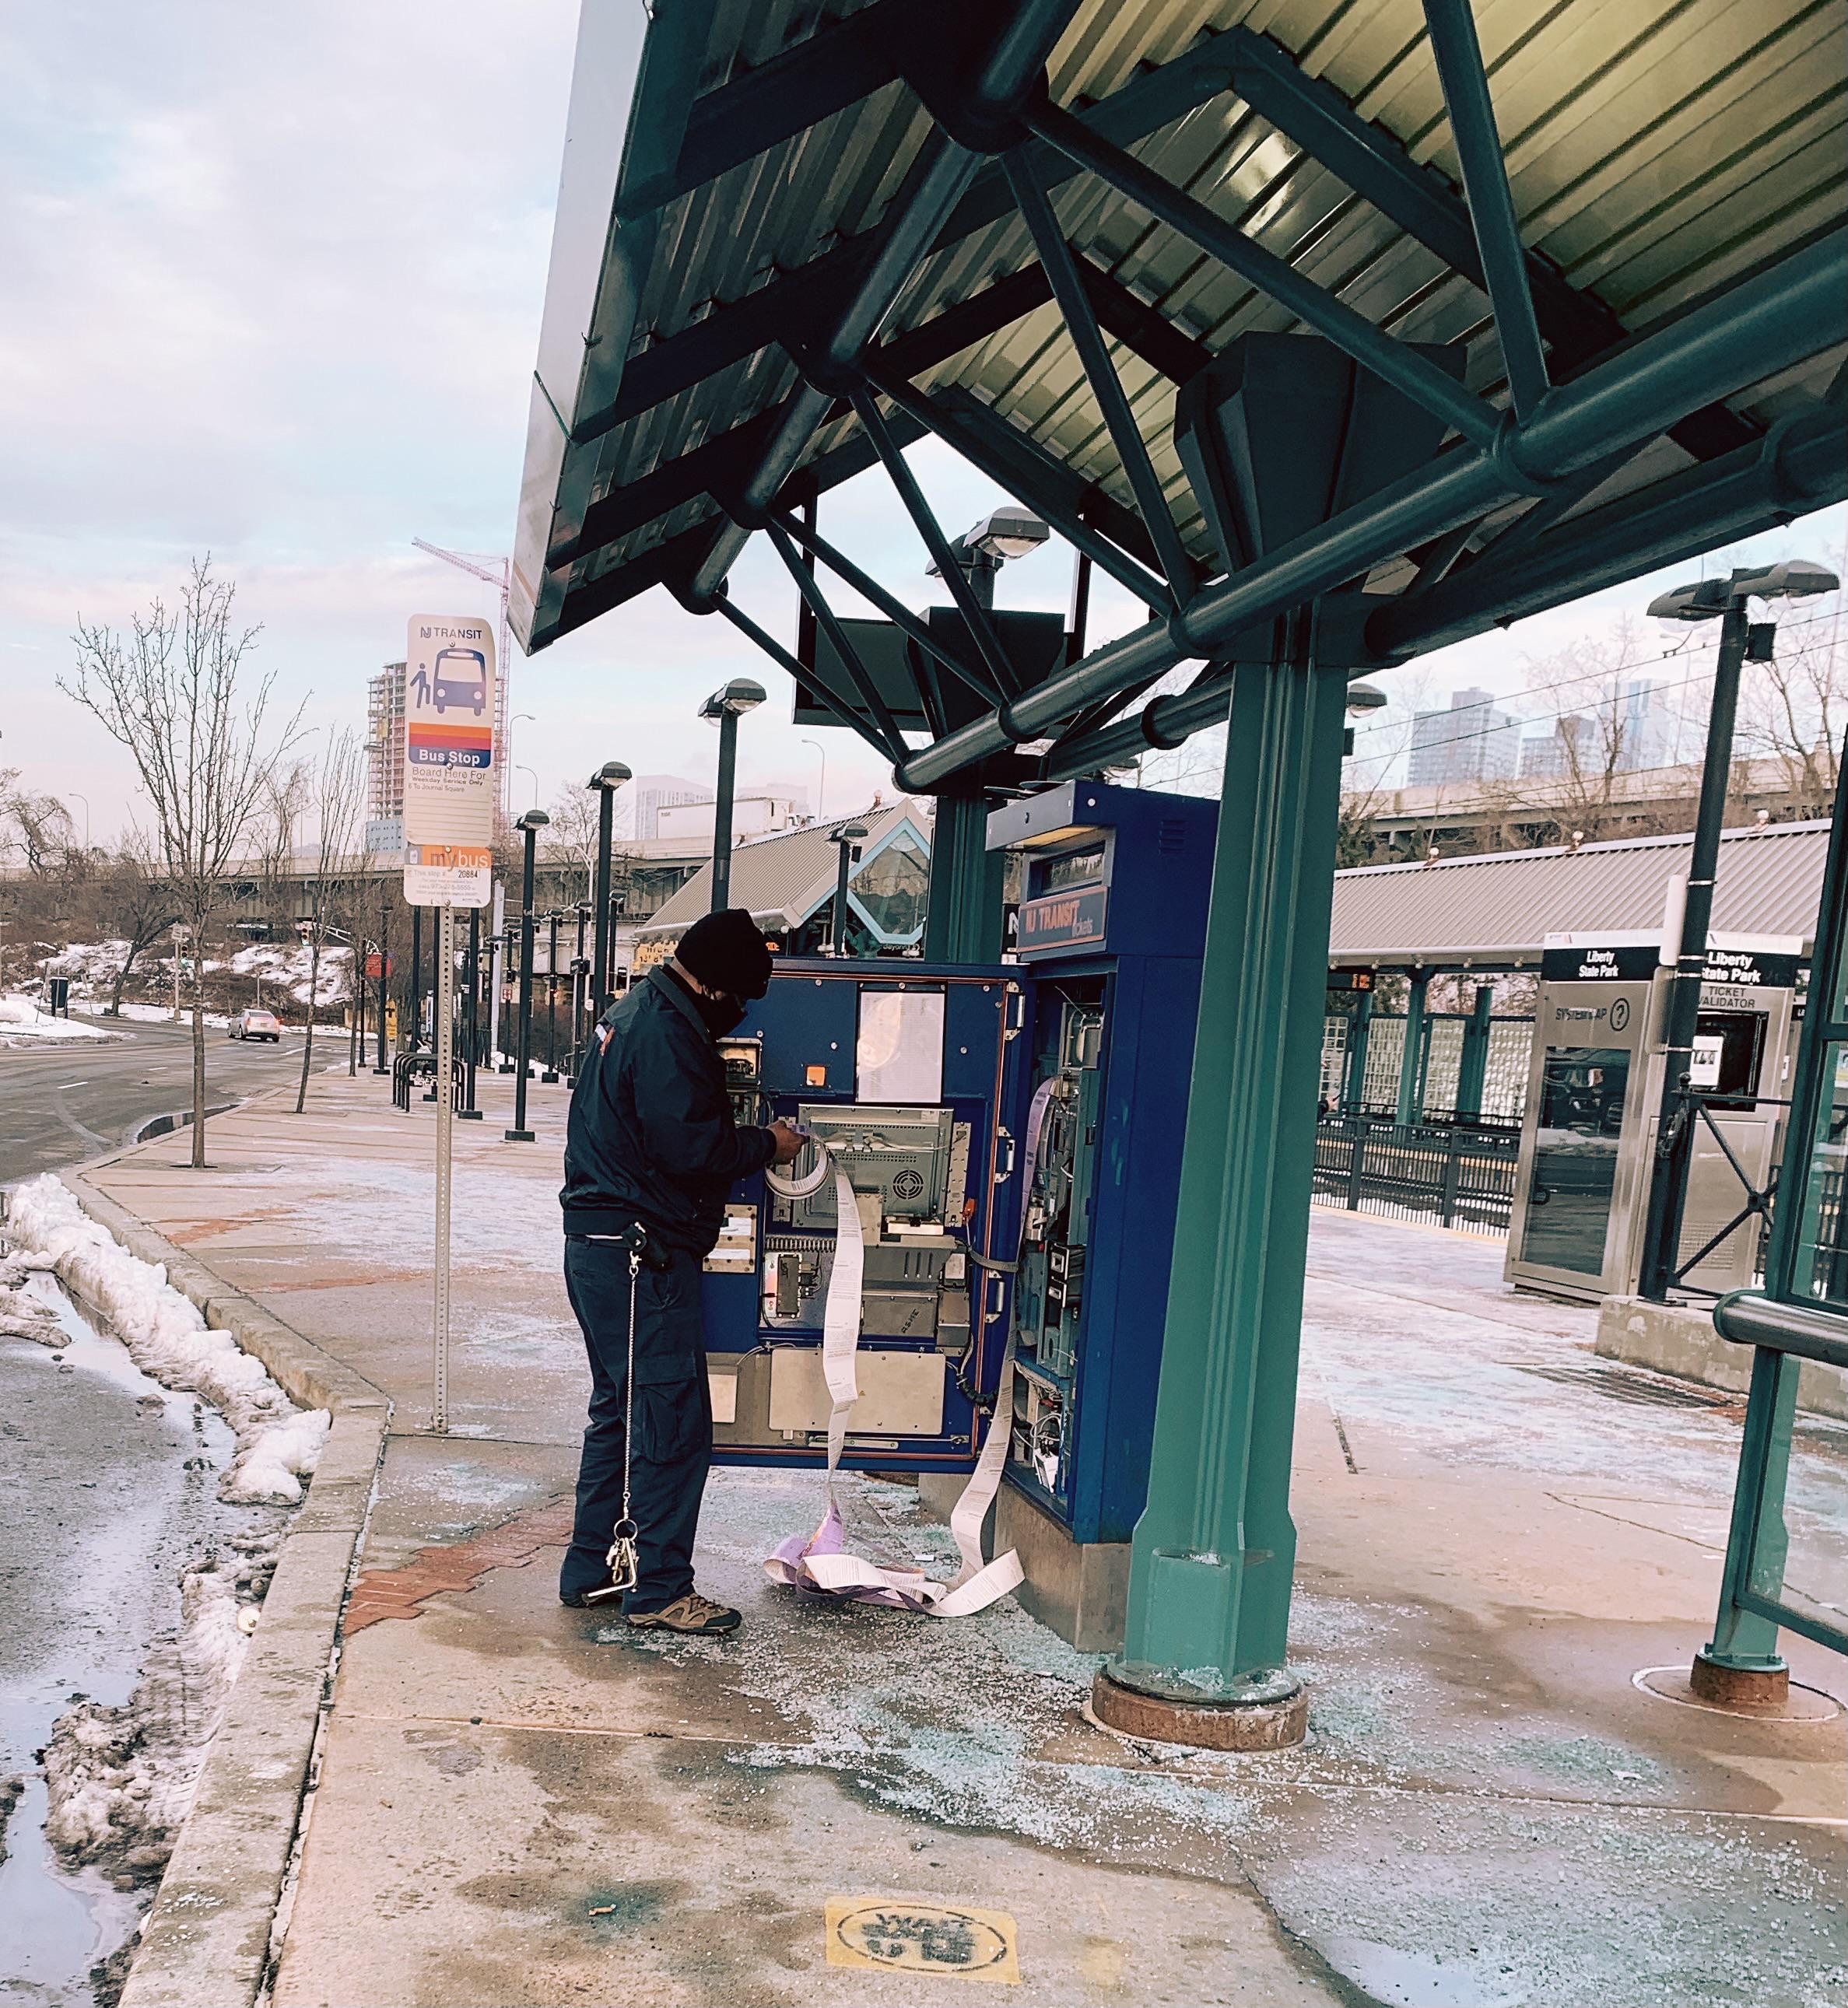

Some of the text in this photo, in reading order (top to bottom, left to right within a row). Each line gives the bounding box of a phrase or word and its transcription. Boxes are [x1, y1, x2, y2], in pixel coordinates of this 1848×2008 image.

[433, 627, 482, 640] TRANSIT
[419, 749, 481, 766] Bus Stop
[412, 767, 486, 780] Board Here For
[458, 870, 479, 879] 20884
[1039, 899, 1080, 932] TRANSIT
[1587, 950, 1615, 965] Liberty
[1708, 951, 1753, 970] Liberty
[1579, 965, 1619, 978] State Park
[1731, 968, 1762, 983] Park
[1709, 986, 1747, 997] TICKET
